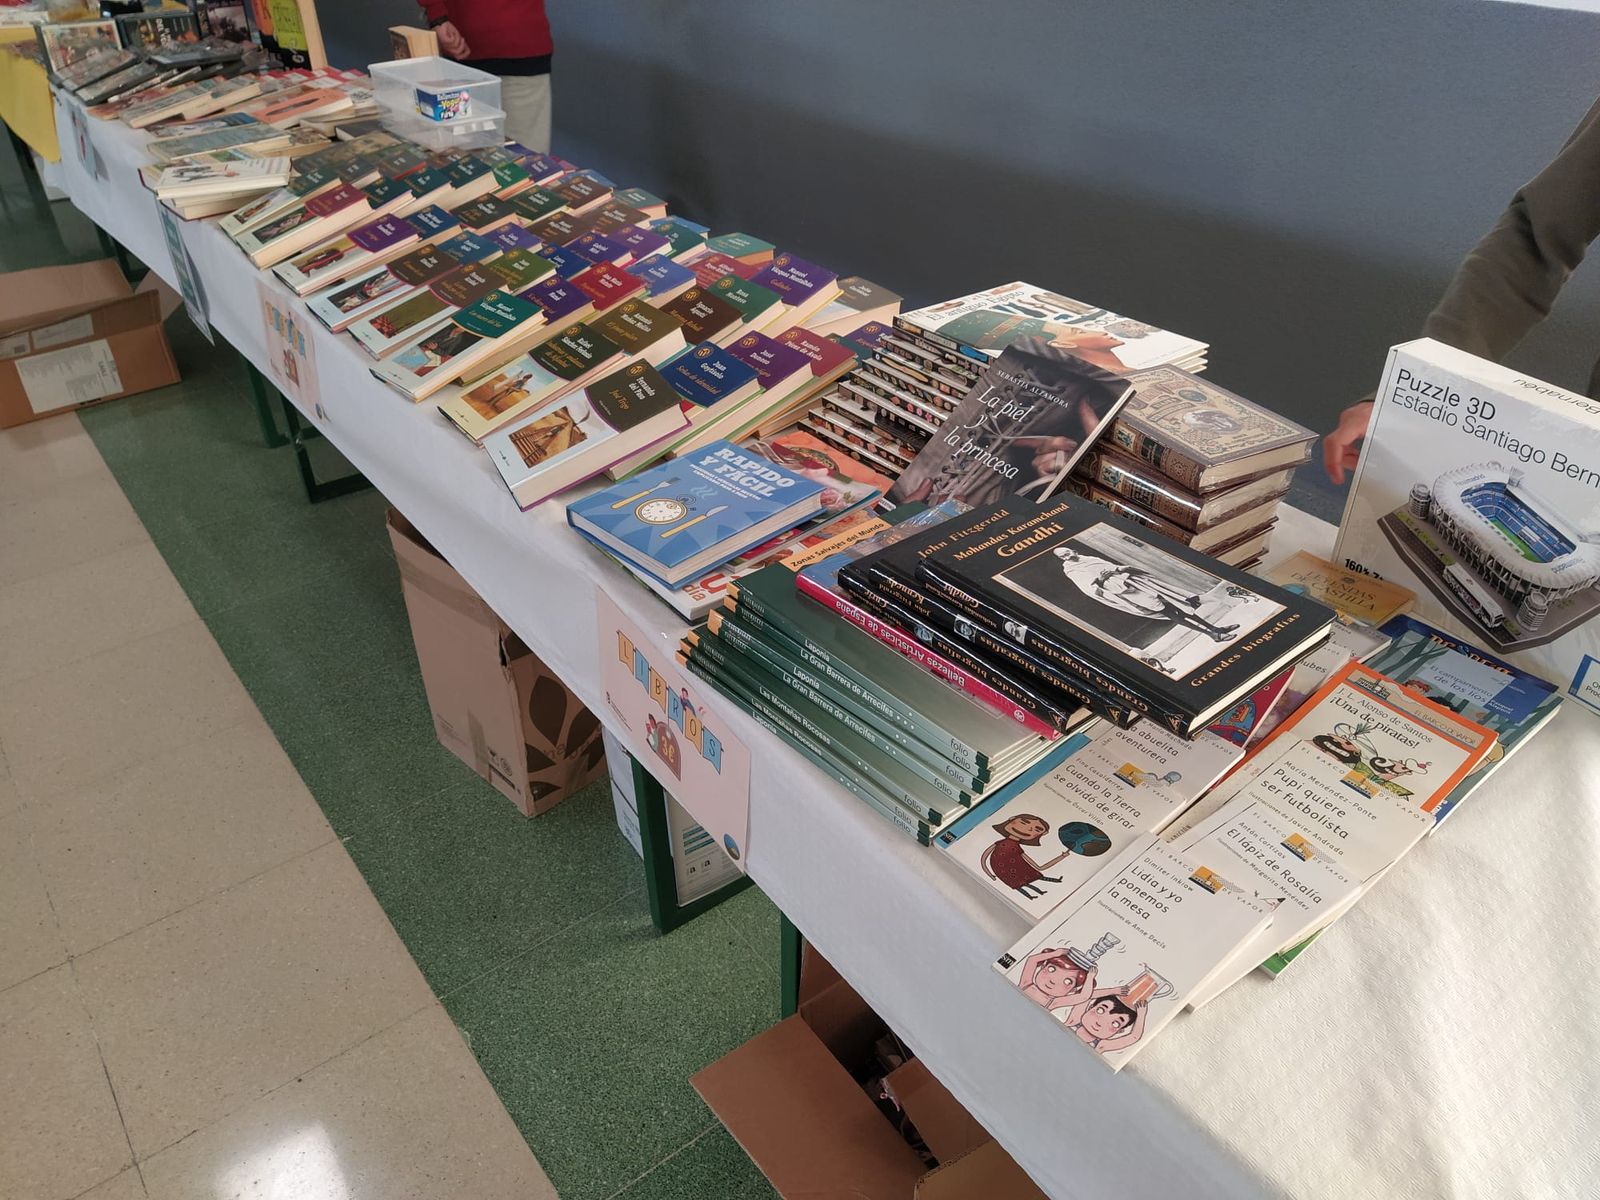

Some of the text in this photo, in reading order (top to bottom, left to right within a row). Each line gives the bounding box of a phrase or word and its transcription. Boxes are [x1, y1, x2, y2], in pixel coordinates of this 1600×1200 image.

[698, 360, 725, 382] Goytisolo
[712, 358, 727, 372] Juan
[626, 380, 647, 401] del Paso
[633, 375, 656, 397] Fernando
[1029, 382, 1068, 407] ALZAMORA
[1396, 368, 1495, 420] Puzzle 3D
[976, 384, 1034, 422] La piel
[963, 412, 989, 434] y
[1392, 386, 1457, 426] Estadio
[1462, 415, 1545, 463] Santiago
[943, 425, 1020, 480] la princesa
[698, 452, 719, 470] Y
[715, 458, 777, 499] FÁCIL
[790, 519, 884, 567] Zonas Salvajes del Mundo
[917, 509, 1009, 558] John Fitzgerald
[953, 502, 1069, 560] Mohandas Karamchand
[997, 522, 1063, 556] Gandhi
[862, 588, 888, 609] Curie
[884, 575, 924, 603] Kennedy
[941, 583, 979, 609] Gandhi
[832, 600, 866, 625] España
[865, 620, 879, 632] de
[801, 639, 829, 663] Laponia
[1190, 611, 1301, 687] Grandes biografías
[791, 666, 822, 690] Laponia
[797, 648, 895, 718] La Gran Barrera de Arrecifes
[925, 655, 966, 686] Bellezas
[1432, 674, 1464, 694] de los
[1439, 670, 1493, 700] campamento
[623, 640, 715, 757] LIBROS
[991, 677, 1035, 708] Grandes
[1041, 671, 1090, 703] Grandes
[1096, 676, 1147, 711] Grandes
[750, 711, 778, 734] Laponia
[756, 686, 832, 745] Las Montañas Rocosas
[780, 672, 877, 743] La Gran Barrera de Arrecifes
[1329, 696, 1419, 748] ¡Una de piratas!
[1336, 685, 1432, 743] J. L. Alonso de Santos
[951, 738, 969, 758] folio
[1115, 726, 1166, 764] aventurera
[1138, 731, 1178, 756] abuelita
[945, 765, 965, 783] folio
[952, 752, 971, 770] folio
[1283, 760, 1306, 778] María
[934, 777, 953, 796] folio
[1053, 773, 1066, 784] se
[1065, 782, 1097, 804] olvidó
[1095, 801, 1109, 813] de
[1106, 811, 1134, 828] girar
[1065, 764, 1100, 791] Cuando
[1100, 787, 1111, 799] la
[1112, 794, 1140, 818] Tierra
[1273, 768, 1345, 817] Pupi quiere
[1316, 755, 1344, 775] BARCO
[1396, 802, 1425, 822] VAPOR
[895, 807, 912, 824] folio
[904, 794, 922, 813] folio
[1260, 780, 1348, 838] ser futbolista
[893, 816, 911, 833] folio
[1238, 820, 1285, 858] Antón Cortizas
[1287, 817, 1343, 855] Javier Andrada
[1143, 855, 1169, 876] Dimiter
[1167, 854, 1193, 872] BARCO
[1226, 827, 1321, 903] El lápiz de Rosalía
[1249, 861, 1278, 887] Margarita
[1117, 877, 1169, 912] ponemos
[1131, 865, 1182, 902] Lidia y yo
[1107, 886, 1150, 919] la mesa
[1131, 922, 1149, 935] Anne
